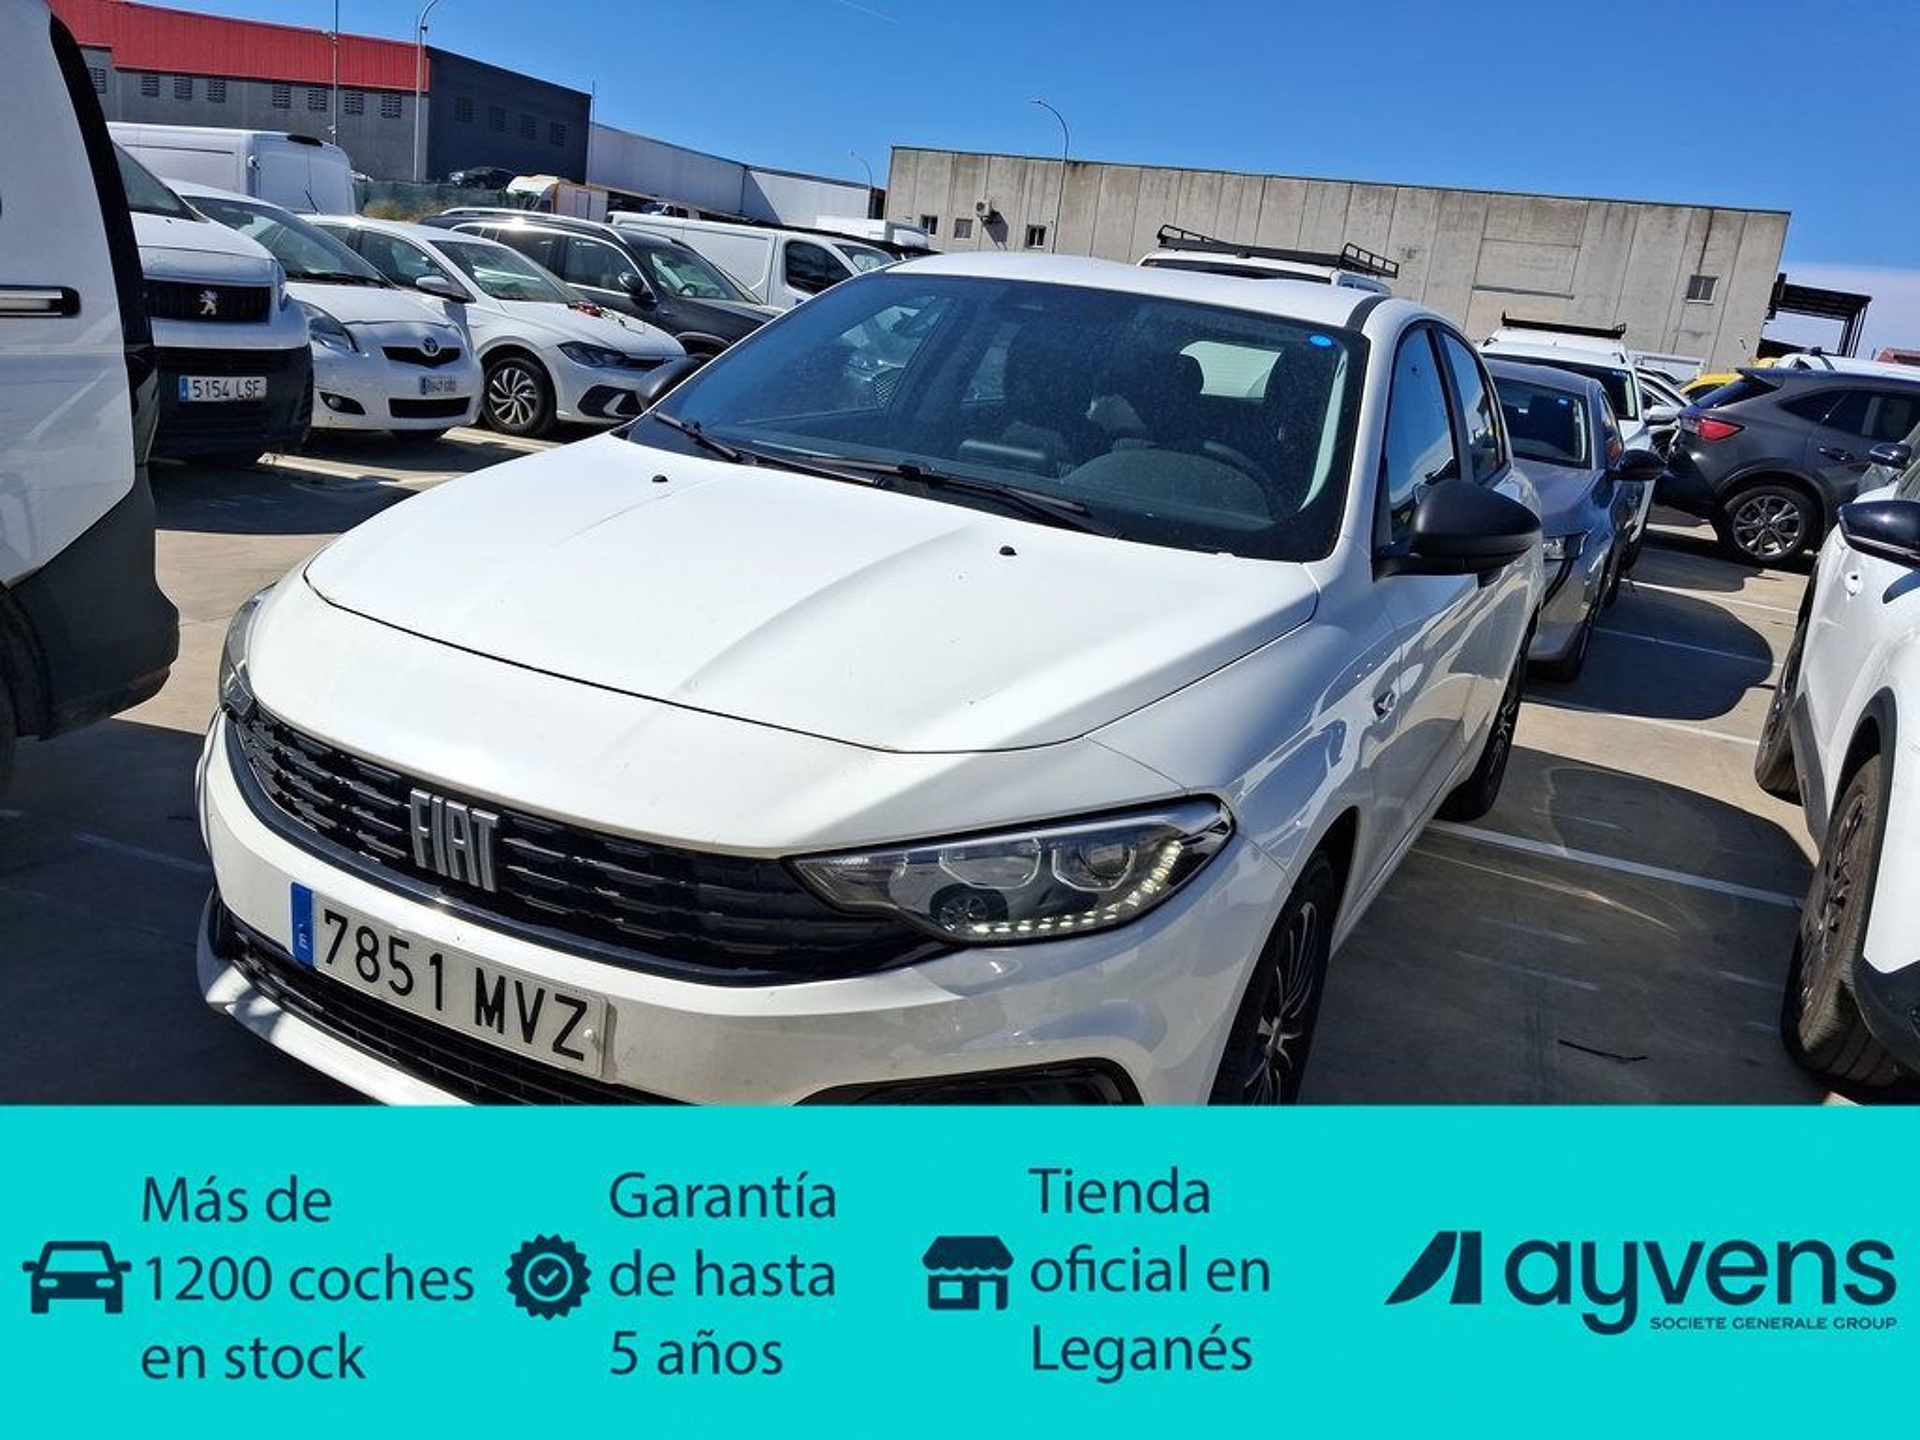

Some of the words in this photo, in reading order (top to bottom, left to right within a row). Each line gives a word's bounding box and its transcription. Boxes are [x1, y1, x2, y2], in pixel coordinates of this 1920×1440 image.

[193, 380, 230, 398] 5154
[410, 788, 501, 893] FIAT
[324, 908, 444, 1012] 7851
[474, 967, 589, 1062] MVZ
